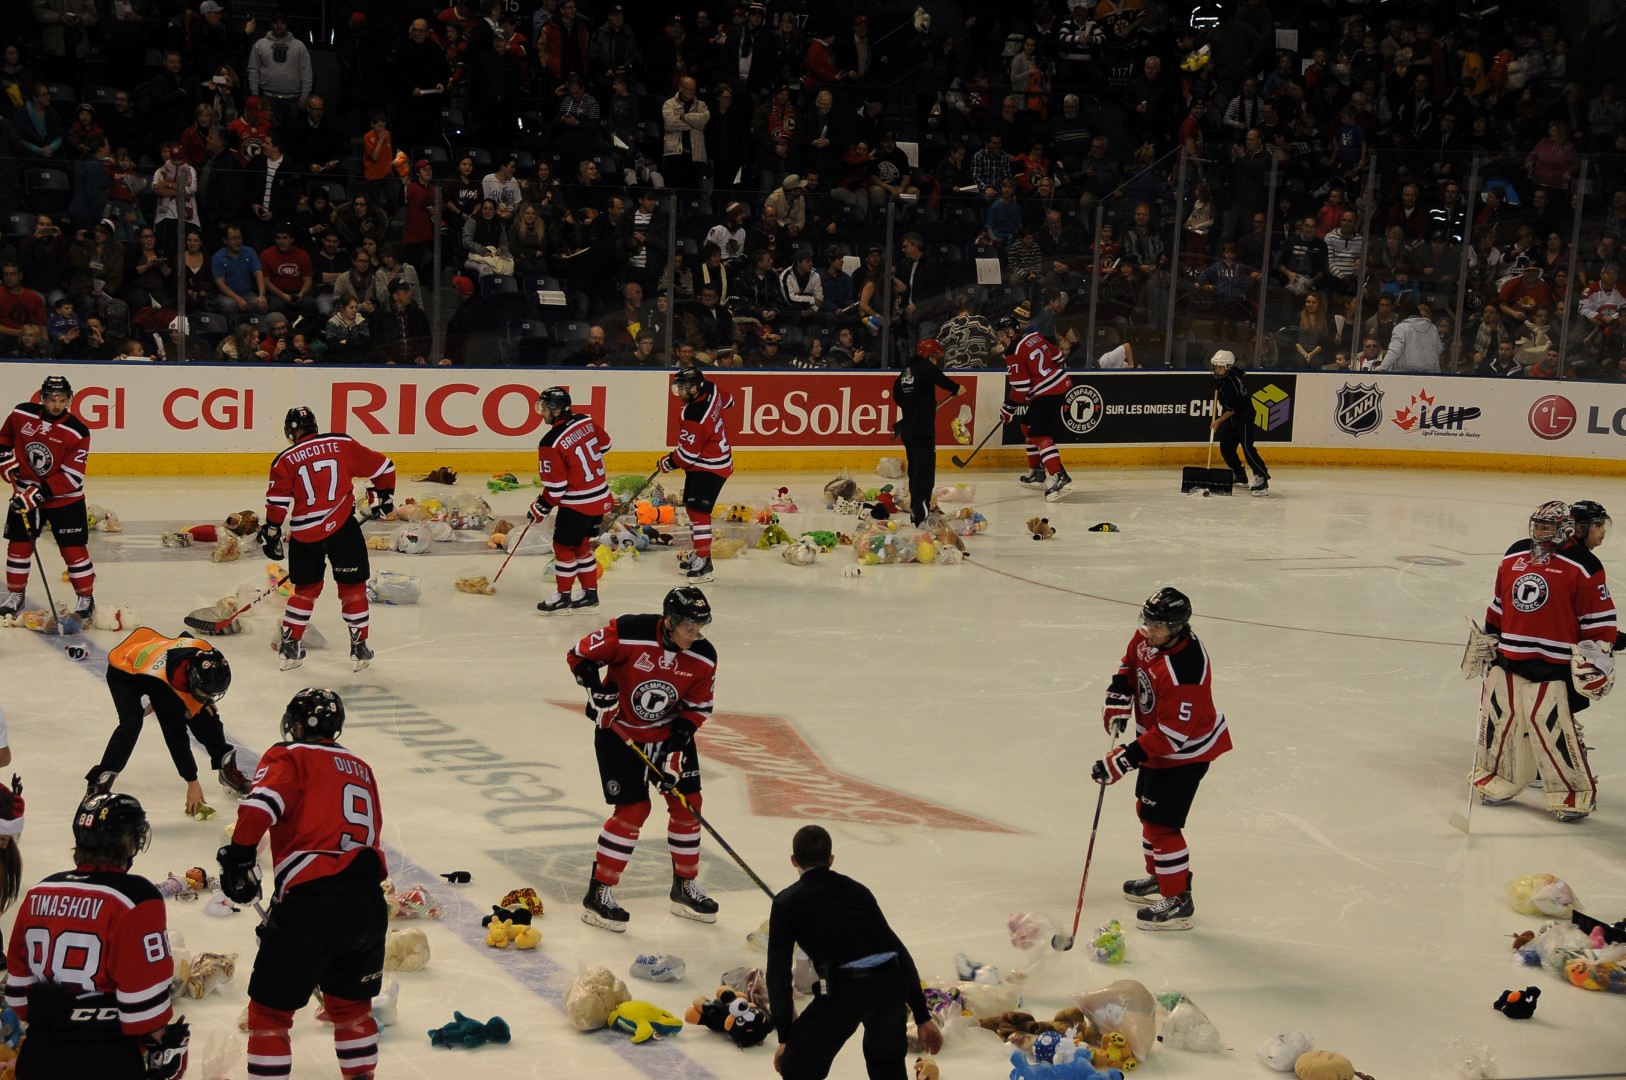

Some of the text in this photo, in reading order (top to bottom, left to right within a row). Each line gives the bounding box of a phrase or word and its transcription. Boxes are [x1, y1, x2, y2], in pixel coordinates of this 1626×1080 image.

[1006, 363, 1019, 375] 27
[1066, 388, 1100, 404] REMPARTS
[162, 387, 254, 430] CGI
[1106, 399, 1224, 417] SUR LES ONDES DE CHY
[1345, 394, 1374, 424] LNH
[1067, 418, 1097, 431] QUÉBEC
[1419, 404, 1465, 431] LCH
[679, 429, 696, 445] 24
[286, 442, 340, 465] TURCOTTE
[574, 436, 606, 483] 15
[539, 460, 552, 473] 15
[297, 458, 339, 507] 17
[1516, 574, 1545, 590] REMPARTS
[1513, 598, 1540, 611] QUÉBEC
[589, 628, 605, 651] 21
[639, 682, 675, 698] REMPARTS
[330, 702, 337, 712] 9
[635, 704, 666, 719] QUÉBEC
[1178, 702, 1193, 721] 5
[251, 765, 270, 785] 9
[333, 756, 371, 785] DUTRA
[79, 813, 95, 826] 88
[339, 782, 376, 852] 9
[29, 893, 104, 921] TIMASHOV
[70, 1007, 120, 1021] CC
